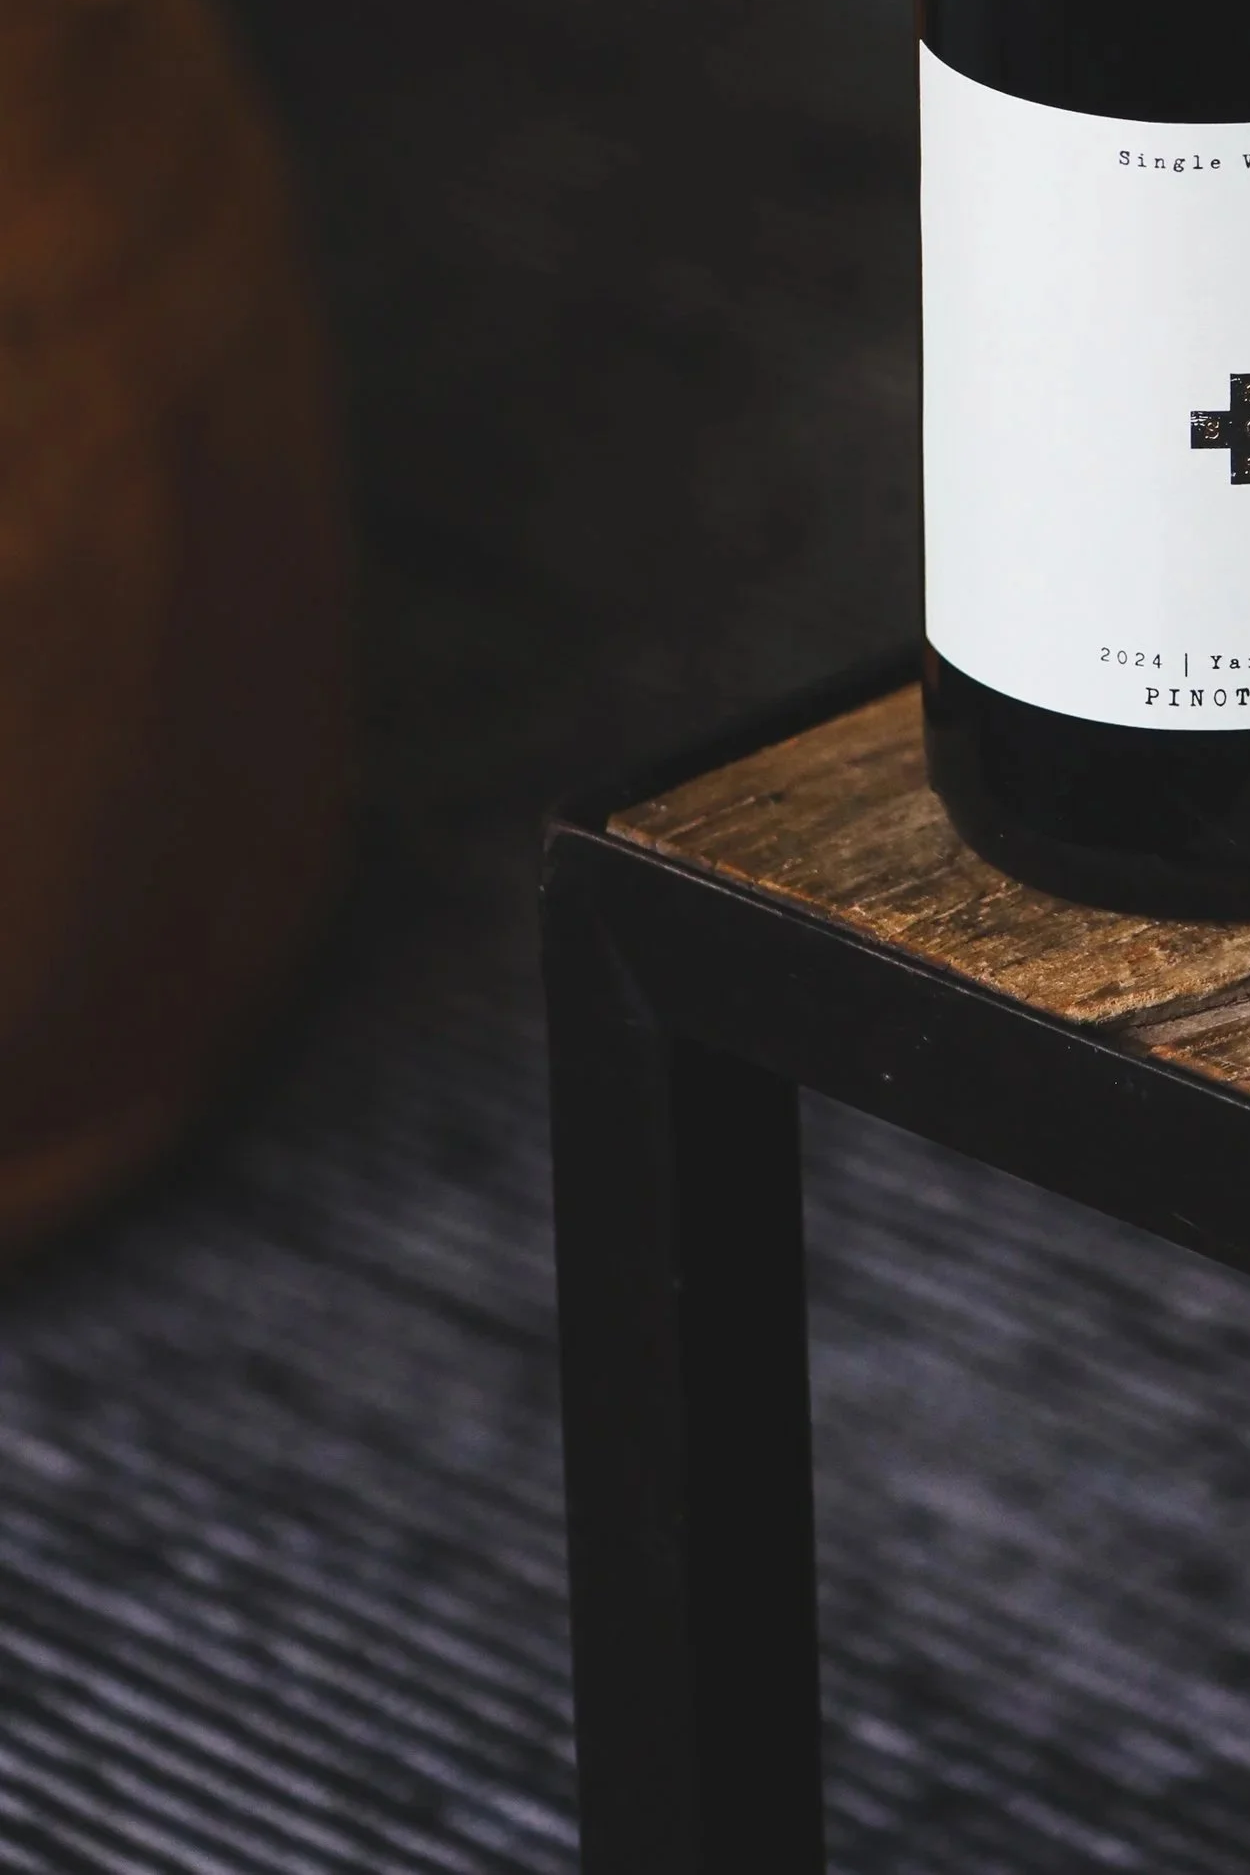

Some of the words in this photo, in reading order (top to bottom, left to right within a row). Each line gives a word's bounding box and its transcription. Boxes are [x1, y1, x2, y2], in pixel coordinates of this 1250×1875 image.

[1119, 150, 1221, 173] Single
[1100, 647, 1163, 669] 2024
[1145, 687, 1250, 707] PINOT
